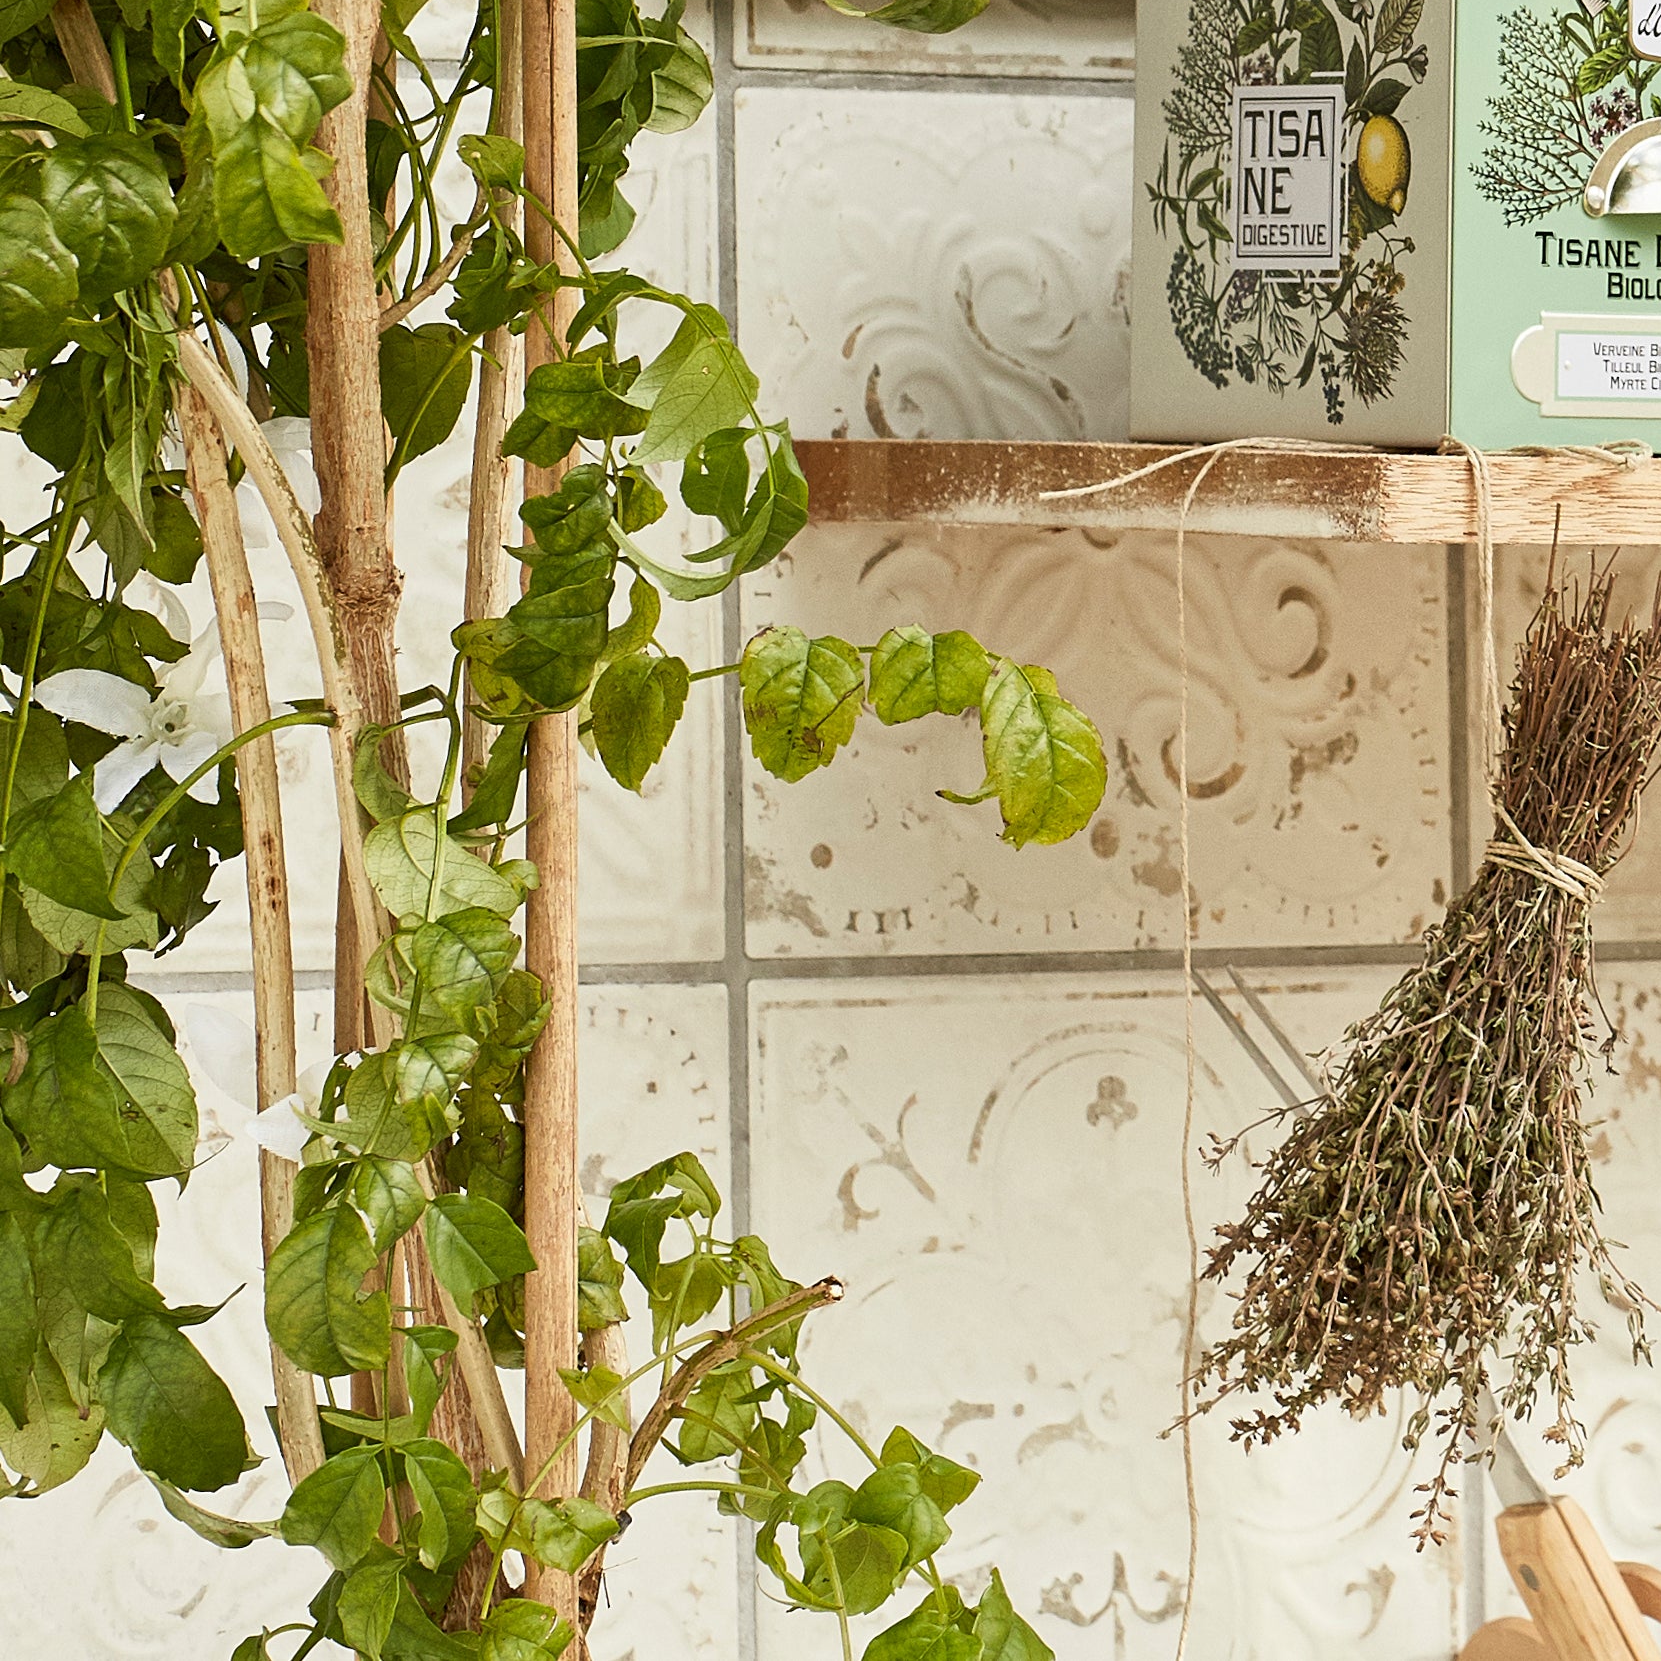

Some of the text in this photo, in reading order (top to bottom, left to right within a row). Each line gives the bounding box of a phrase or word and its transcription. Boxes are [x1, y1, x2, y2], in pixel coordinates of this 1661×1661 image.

[1243, 109, 1327, 160] TISA
[1242, 166, 1293, 216] NE
[1242, 223, 1327, 247] DIGESTIVE
[1534, 230, 1641, 269] TISANE
[1593, 342, 1646, 357] VERVEINE
[1603, 359, 1644, 374] TILLEUL
[1610, 376, 1647, 390] MYRTE
